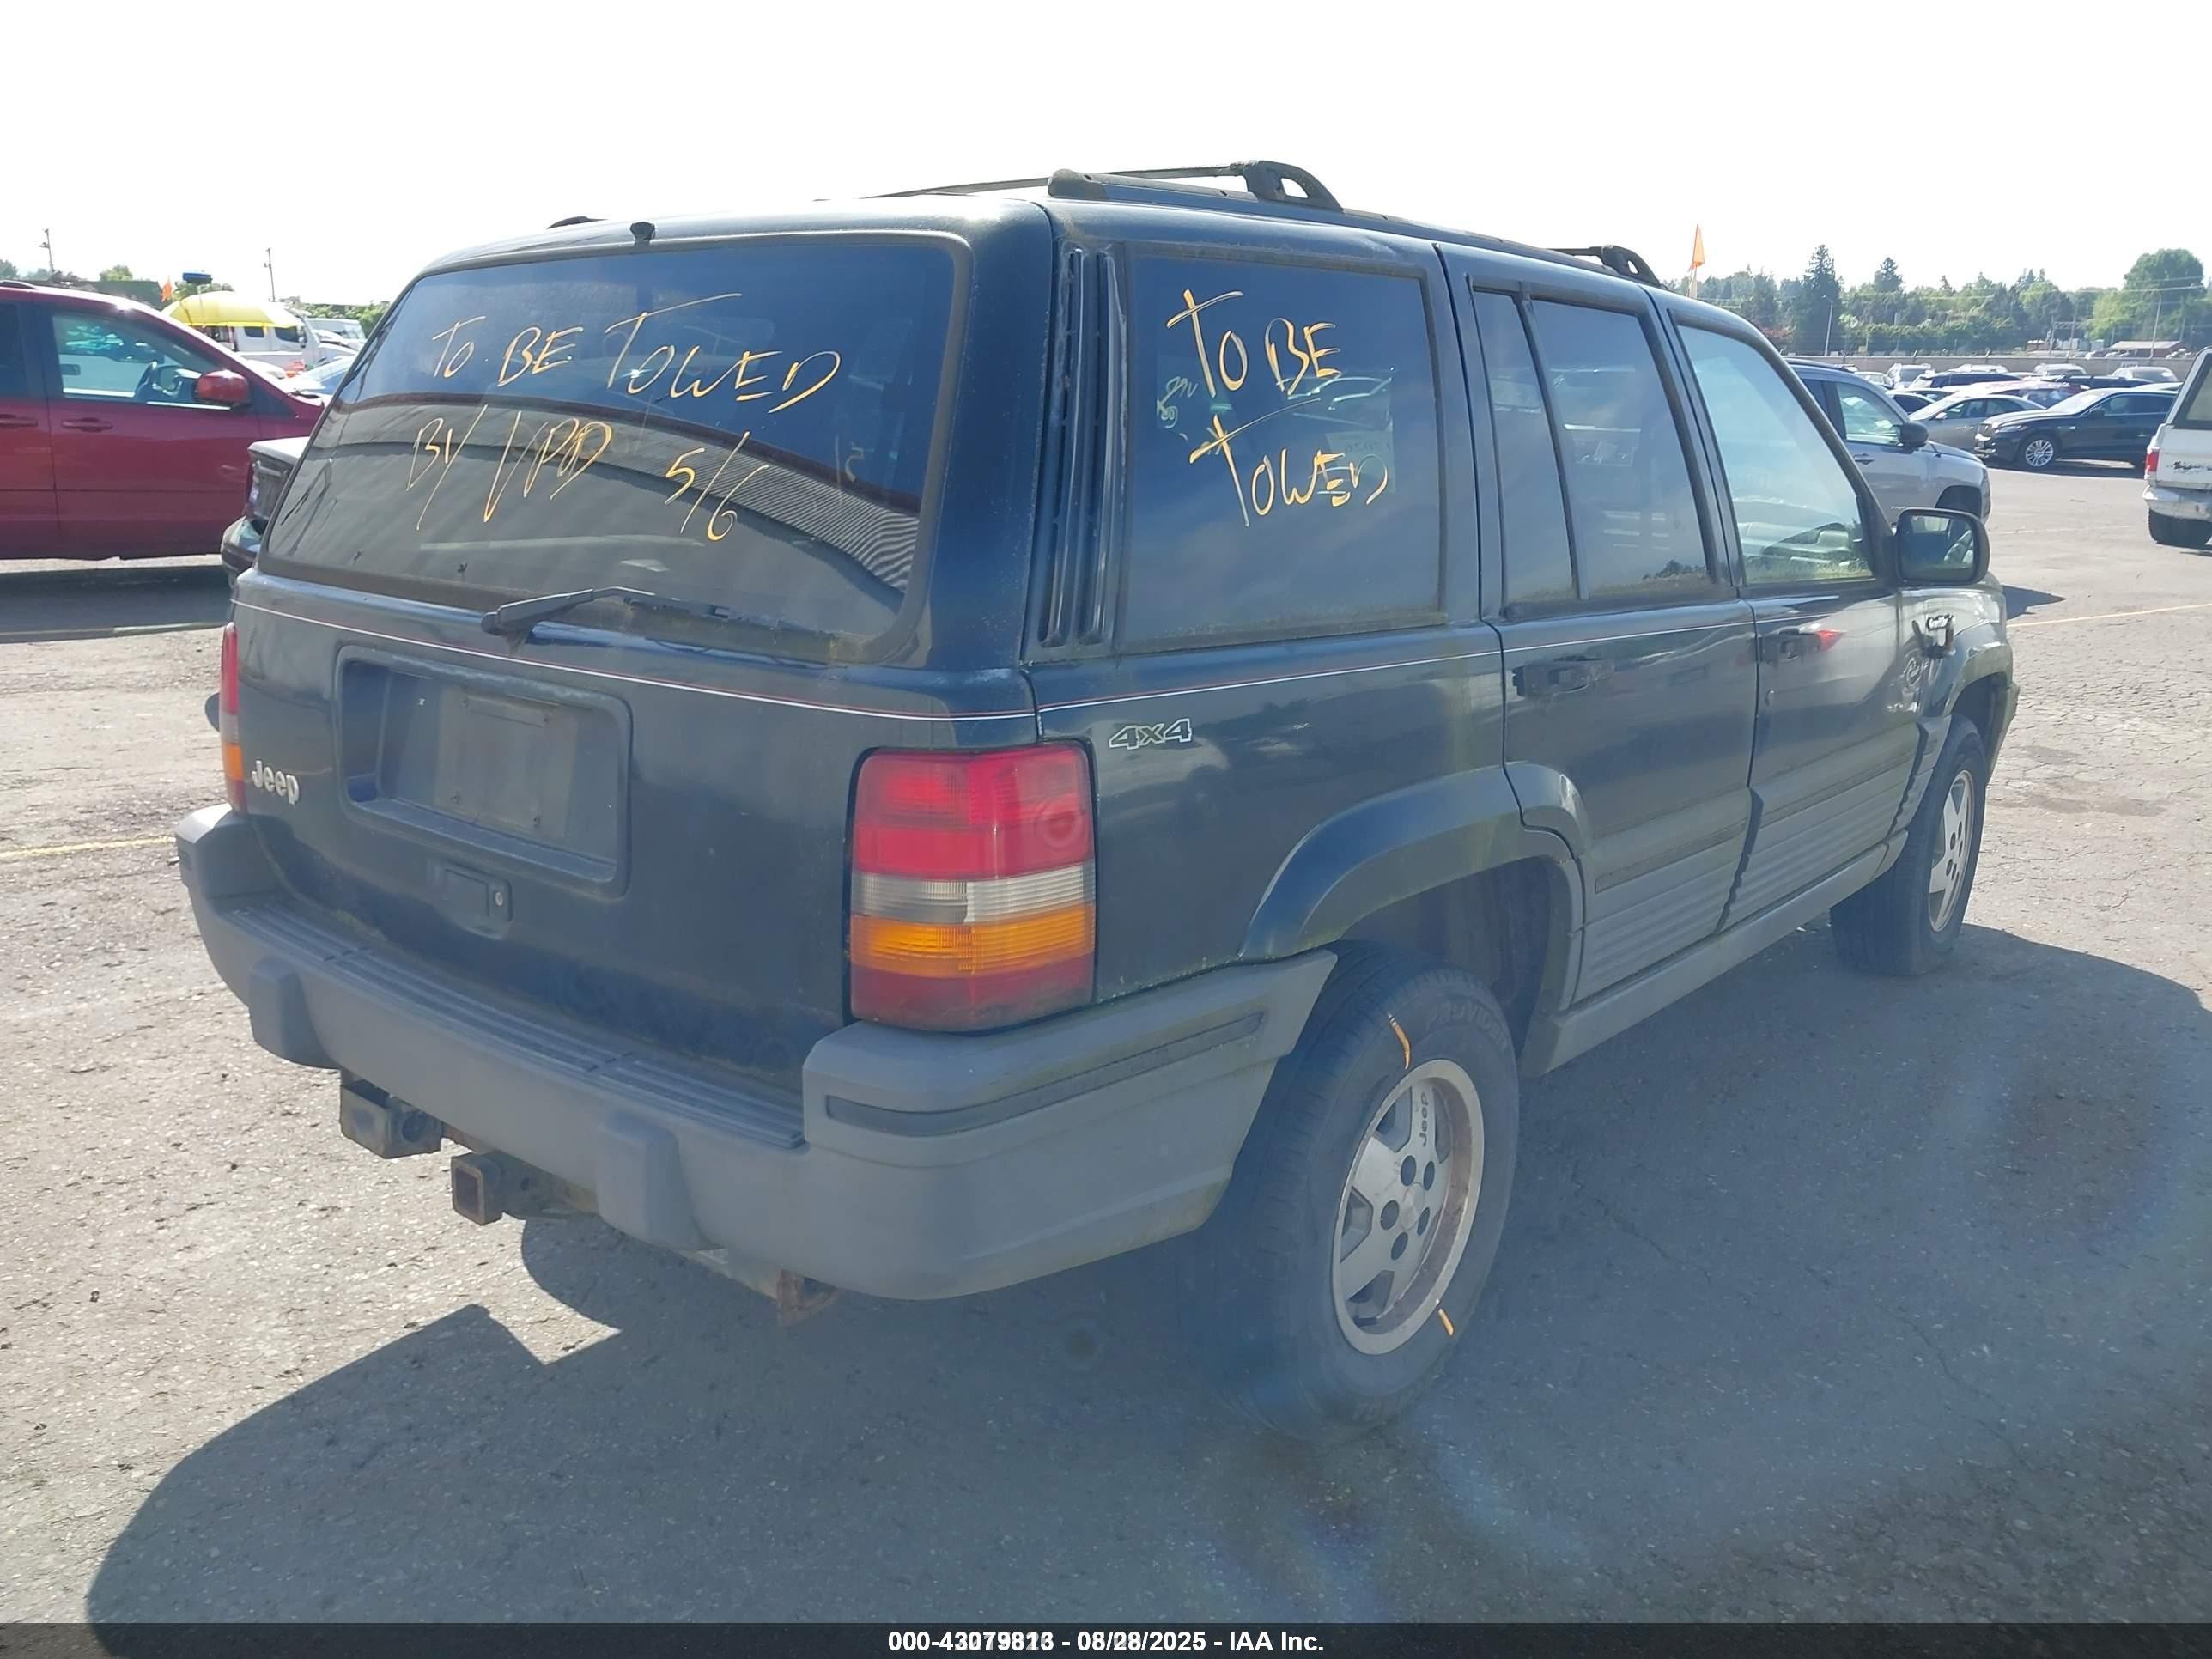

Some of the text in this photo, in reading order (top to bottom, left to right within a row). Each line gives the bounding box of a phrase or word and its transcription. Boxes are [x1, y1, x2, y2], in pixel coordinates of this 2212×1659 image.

[496, 326, 585, 387] BE
[604, 292, 842, 414] TOWED
[1264, 317, 1341, 396] BE
[405, 404, 489, 531] BY
[664, 431, 770, 542] 5/6
[1188, 397, 1389, 527] TOWED
[252, 760, 300, 805] Jeep
